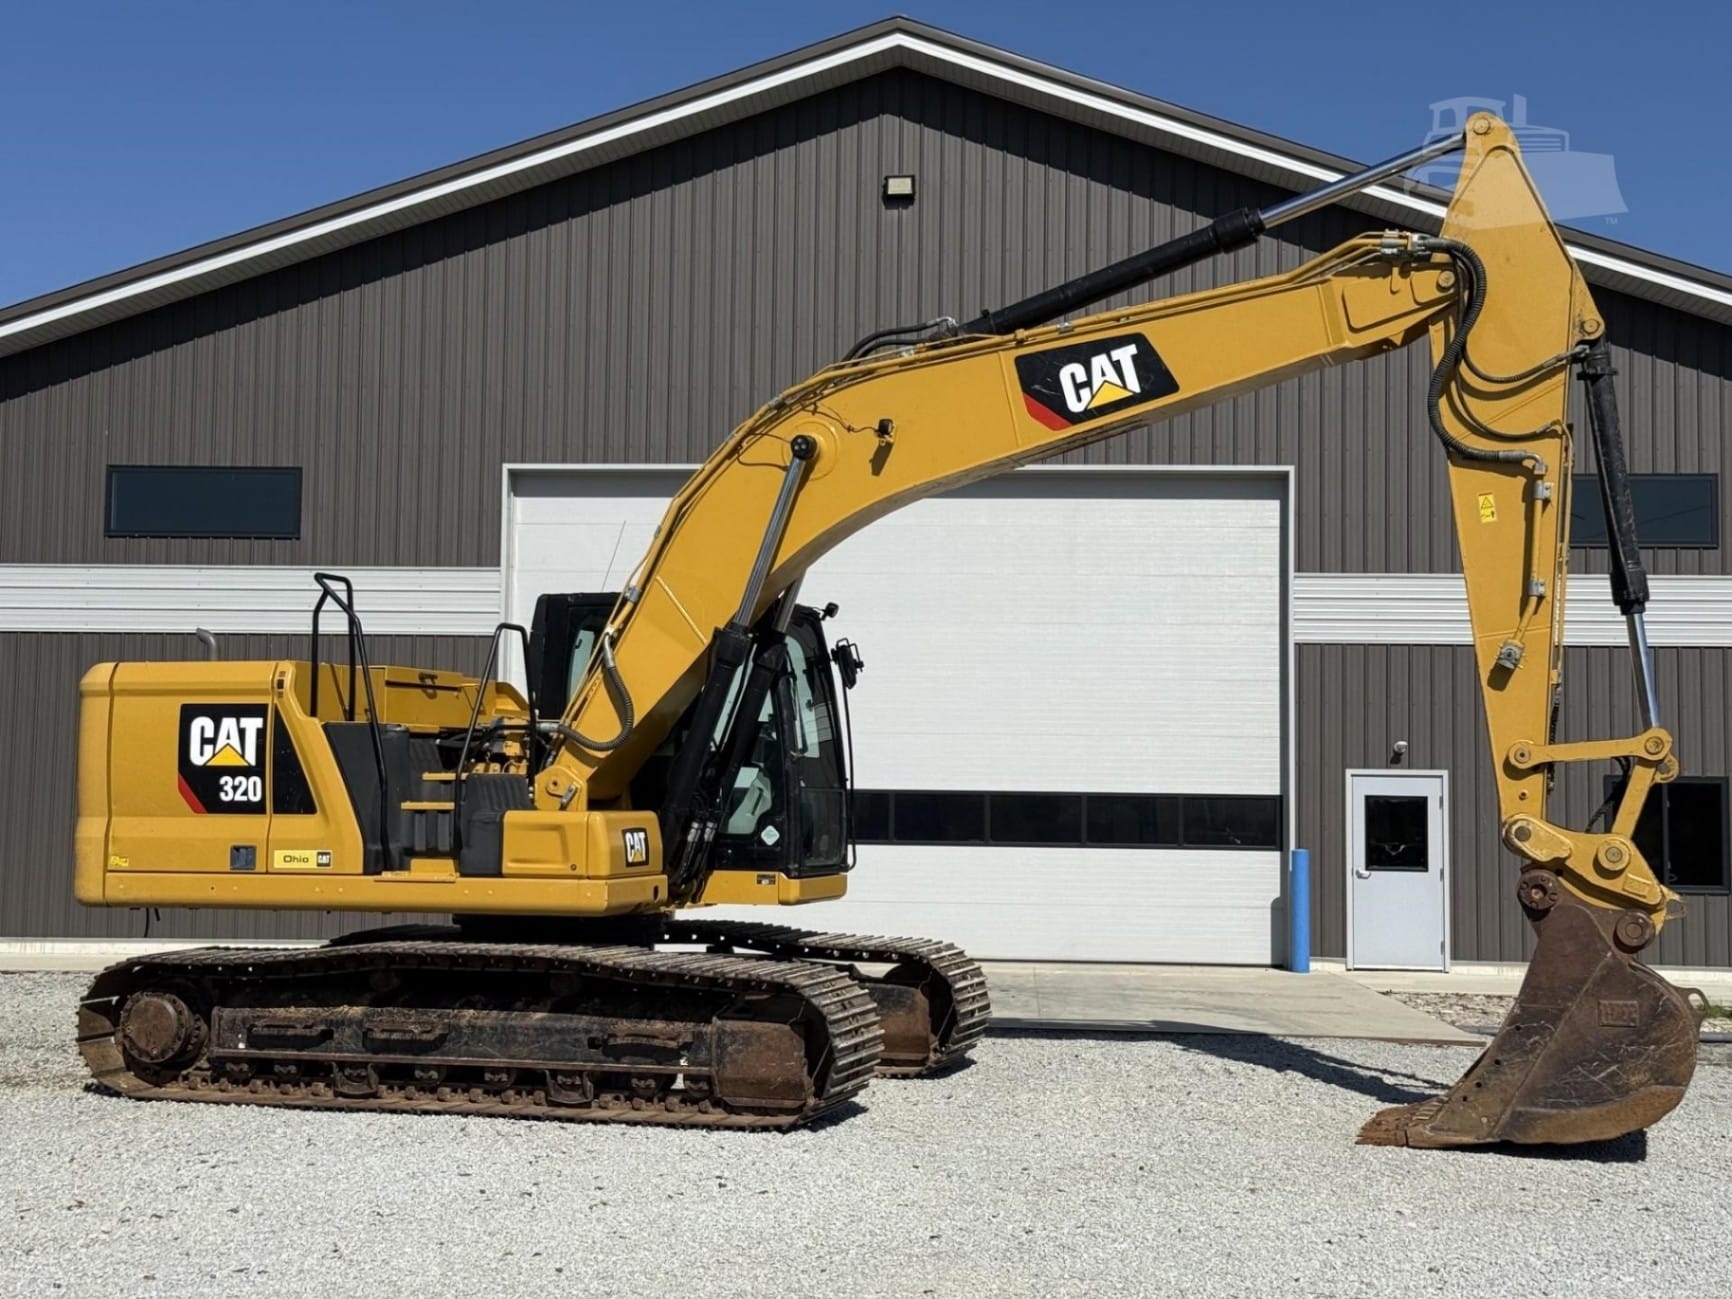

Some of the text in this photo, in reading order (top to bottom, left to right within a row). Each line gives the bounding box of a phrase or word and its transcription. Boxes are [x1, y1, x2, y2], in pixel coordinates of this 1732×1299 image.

[1059, 344, 1141, 413] CAT
[189, 716, 264, 767] CAT
[219, 775, 262, 802] 320
[283, 854, 310, 864] Ohio
[625, 831, 646, 863] CAT
